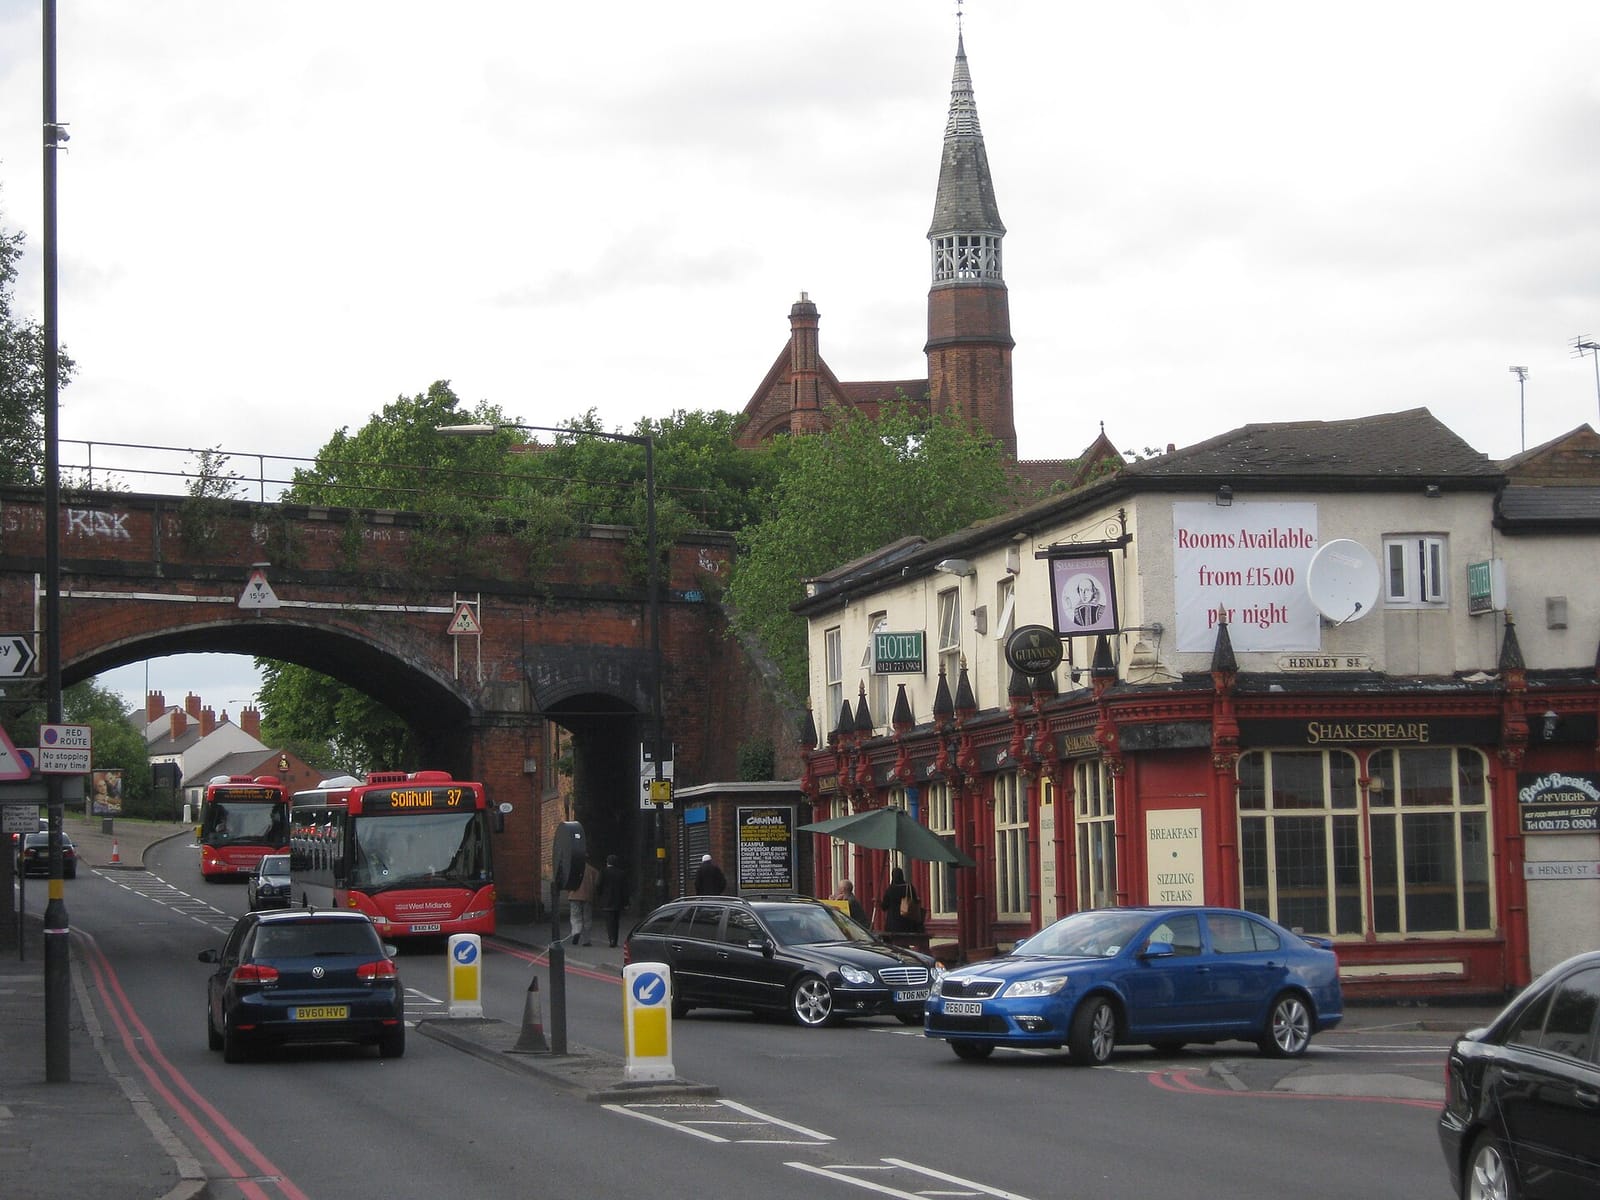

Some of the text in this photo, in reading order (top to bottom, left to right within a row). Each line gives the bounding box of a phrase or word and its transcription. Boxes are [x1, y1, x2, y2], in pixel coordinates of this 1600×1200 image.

[1178, 527, 1313, 549] Rooms Available
[1198, 564, 1294, 587] from £15.00
[1208, 602, 1289, 629] pr night
[877, 635, 920, 660] HOTEL
[1289, 658, 1338, 668] HENLEY
[1307, 721, 1430, 744] SHAKESPEARE
[60, 738, 88, 746] ROUTE
[56, 752, 89, 762] stopping
[264, 790, 274, 800] 37
[1519, 777, 1546, 802] Bed
[391, 789, 462, 807] Solihull 37
[1526, 820, 1538, 830] Tel
[1572, 818, 1597, 829] 0904
[1150, 827, 1198, 841] BREAKFAST
[1538, 865, 1589, 875] HENLEY ST
[1157, 872, 1195, 886] SIZZLING
[1160, 889, 1193, 903] STEAKS
[408, 902, 425, 910] West
[424, 901, 452, 909] Midlands
[298, 1007, 346, 1018] BV60 HVC
